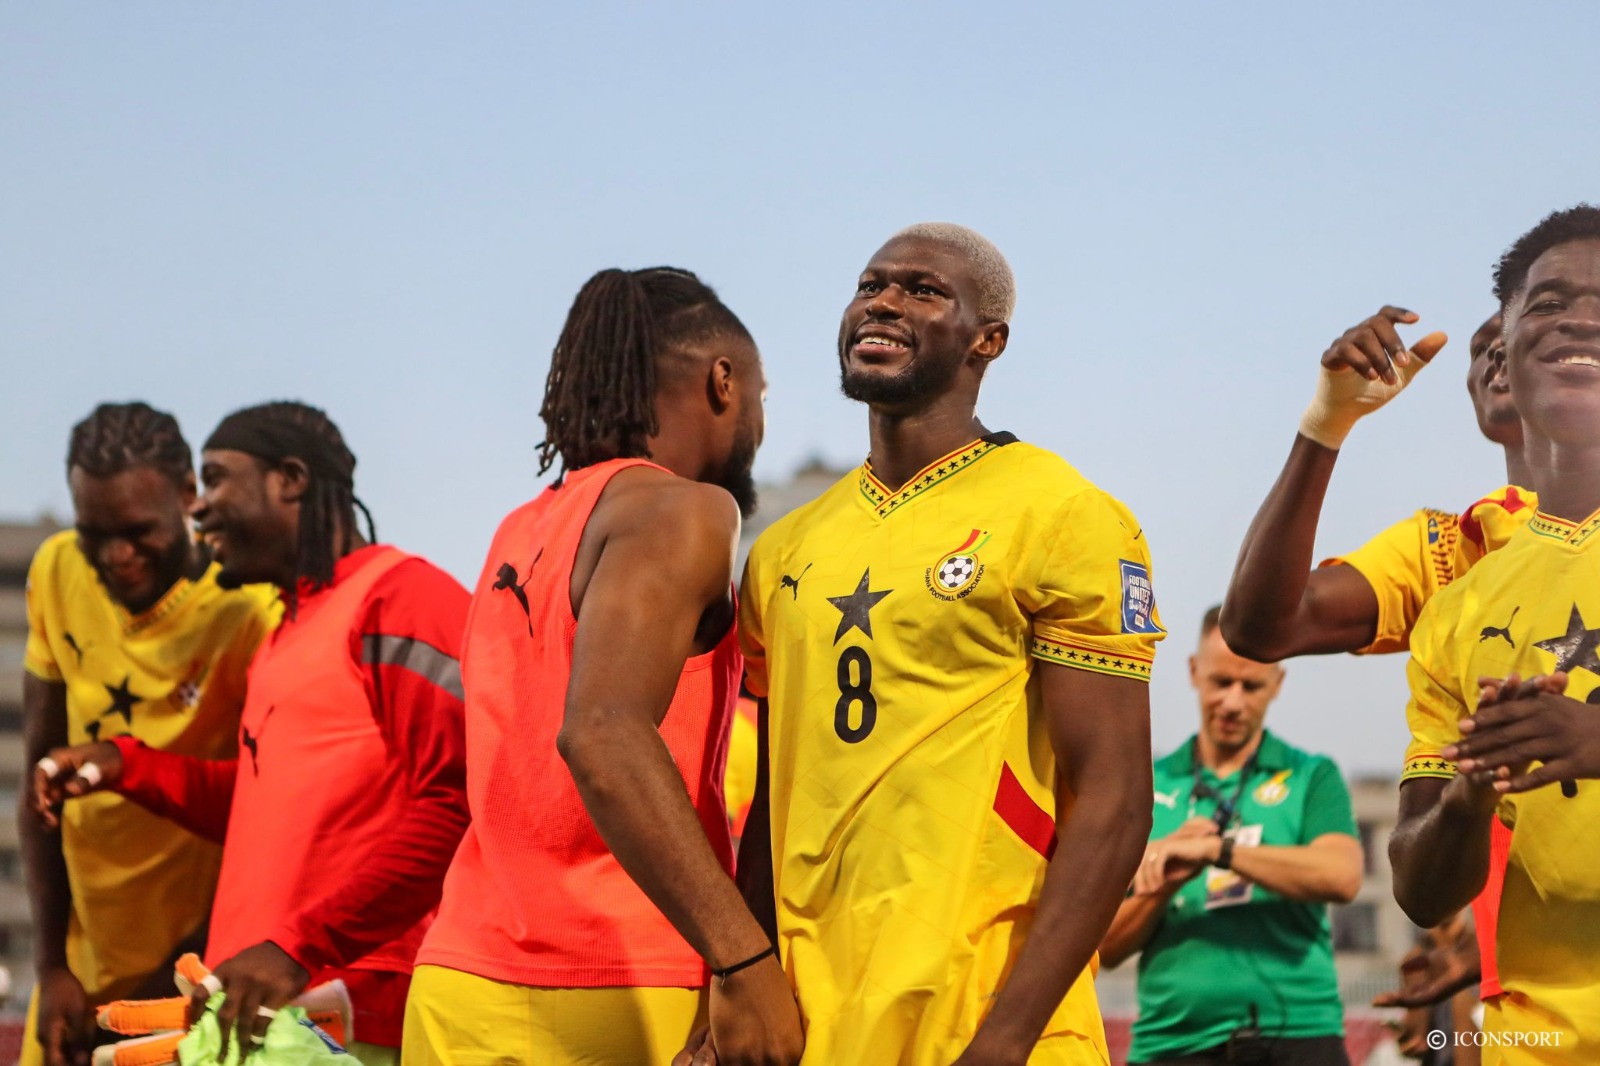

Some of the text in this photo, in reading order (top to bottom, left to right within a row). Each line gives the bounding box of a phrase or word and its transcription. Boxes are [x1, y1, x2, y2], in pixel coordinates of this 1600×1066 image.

[929, 587, 955, 601] FOOTBALL
[957, 565, 984, 599] ASSOCIATION
[1129, 585, 1151, 605] UNITES
[834, 646, 877, 744] 8
